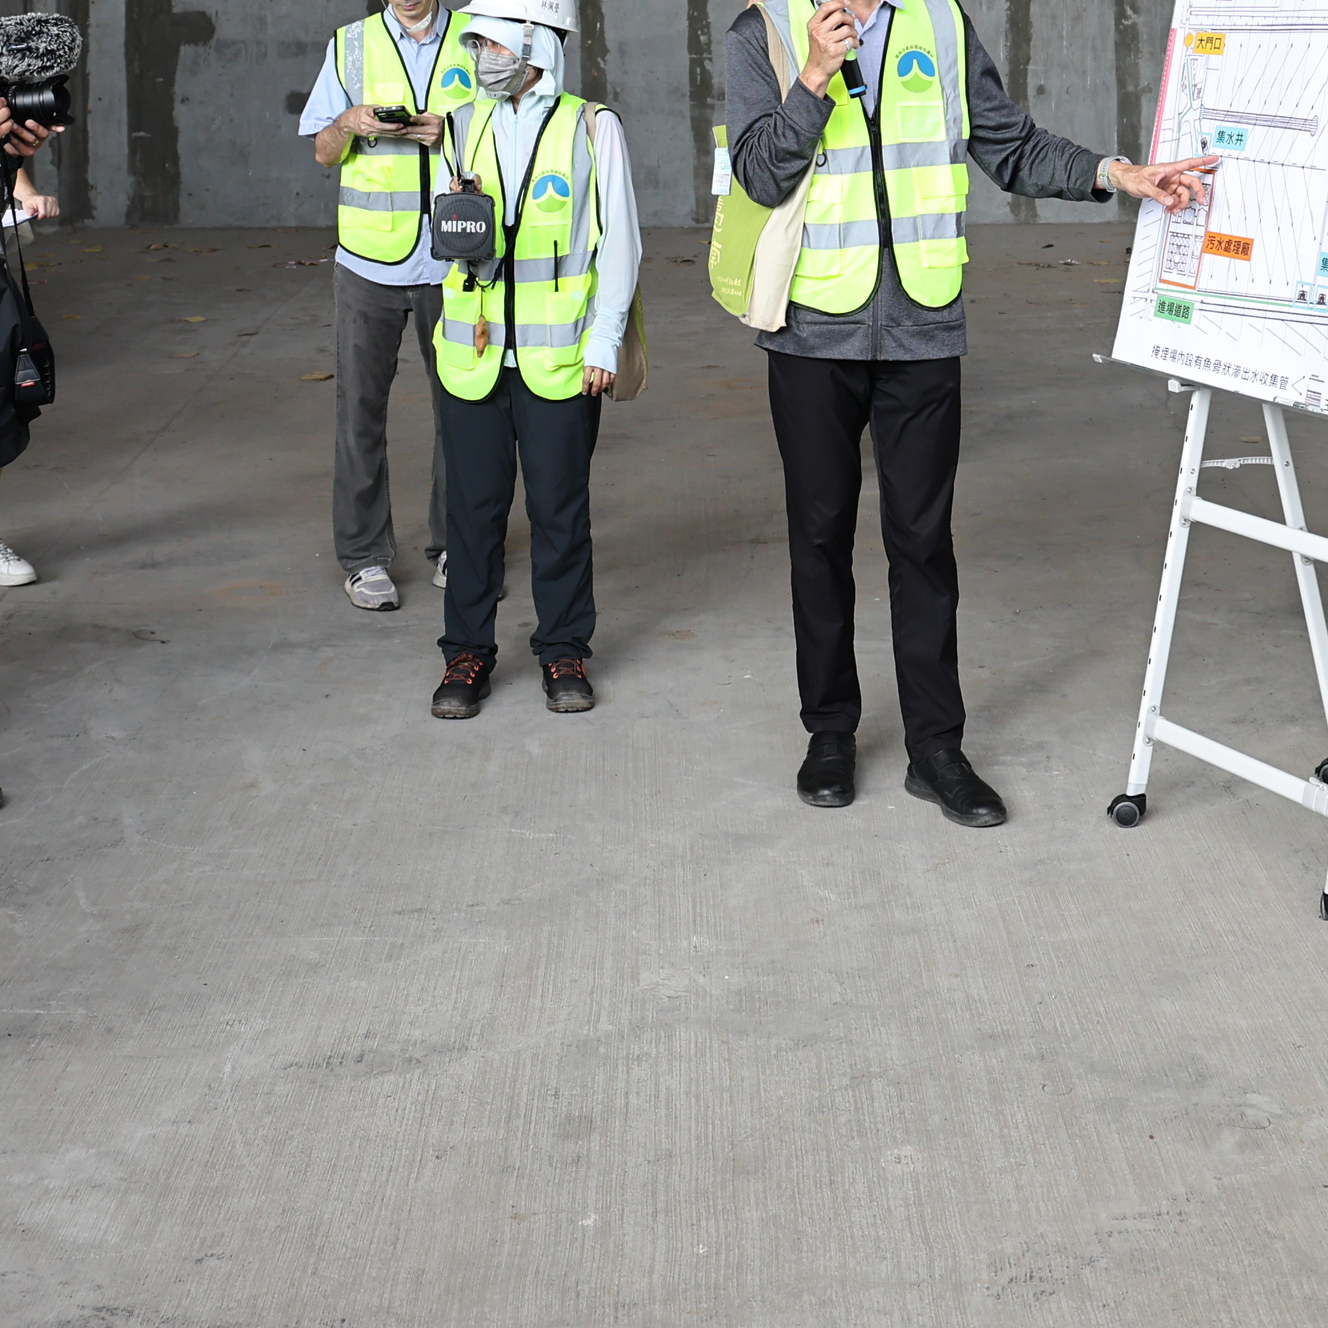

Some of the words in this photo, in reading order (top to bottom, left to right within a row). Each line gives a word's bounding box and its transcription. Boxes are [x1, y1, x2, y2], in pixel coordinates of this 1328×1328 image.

[1196, 36, 1222, 50] 大門口
[1216, 130, 1245, 146] 集水井
[1205, 235, 1251, 257] 污水處理廠
[1157, 299, 1190, 320] 進場道路
